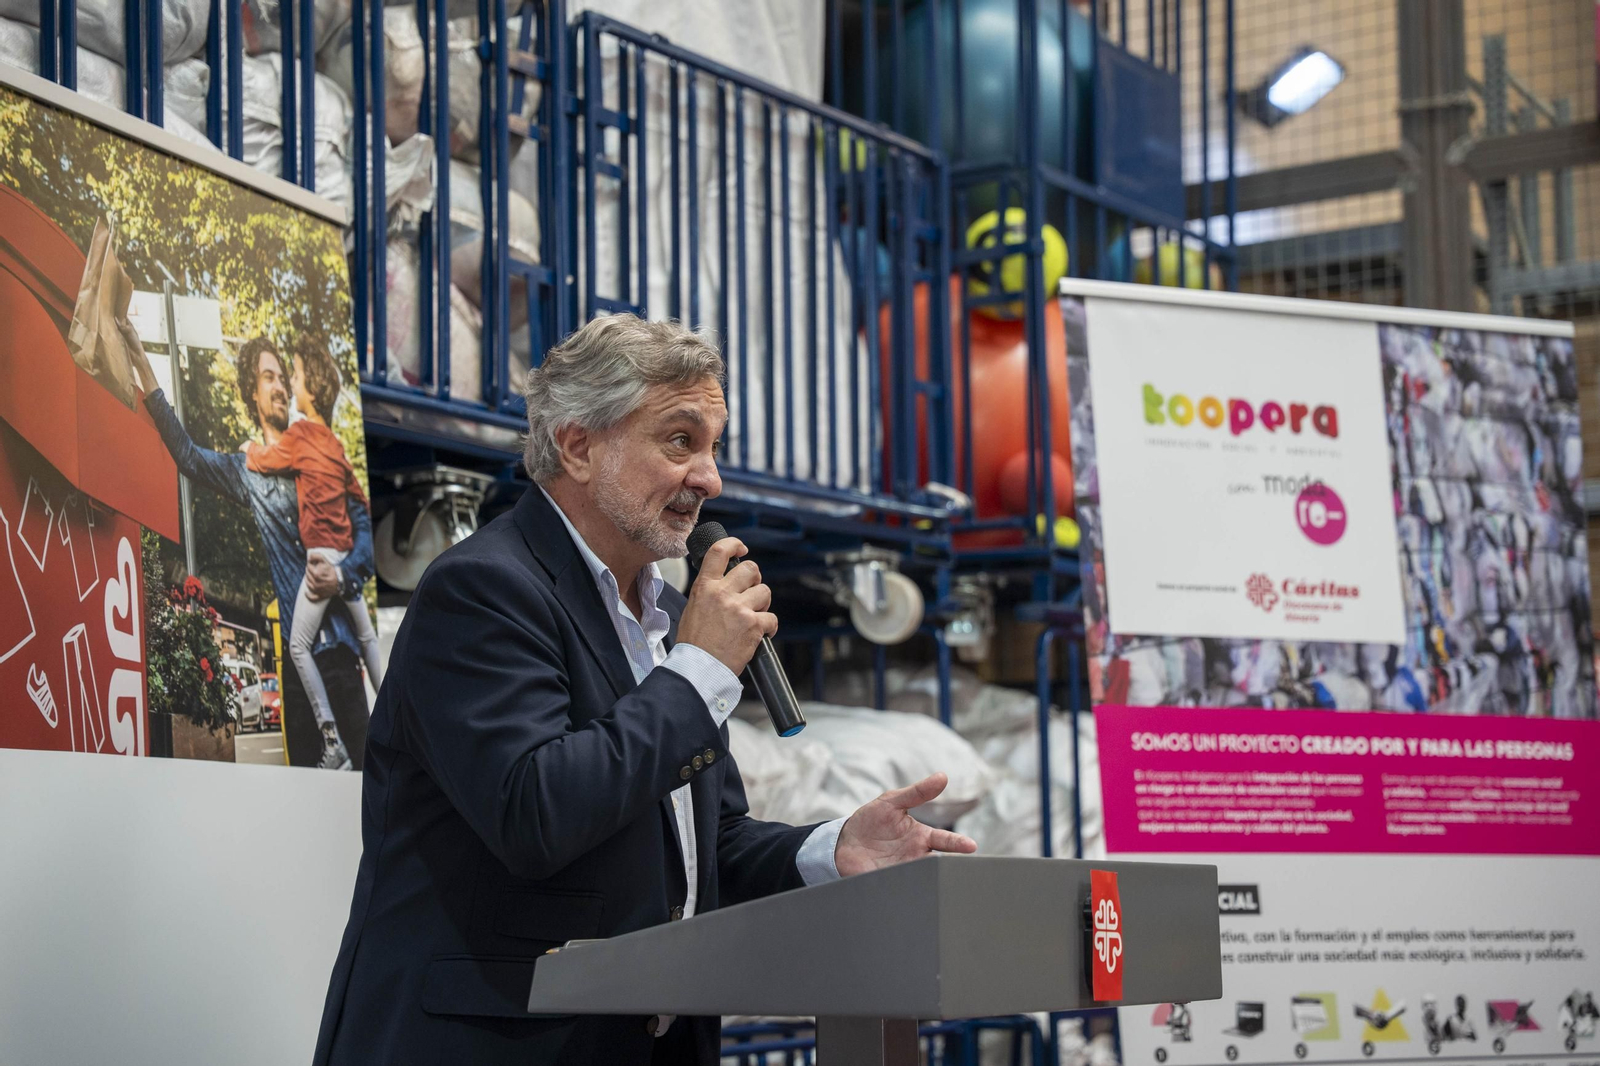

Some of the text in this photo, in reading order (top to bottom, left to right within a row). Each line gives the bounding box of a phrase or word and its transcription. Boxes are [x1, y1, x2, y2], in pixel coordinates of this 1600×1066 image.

[1142, 382, 1339, 438] koopera
[1262, 474, 1328, 497] moda
[1281, 577, 1360, 599] Cáritas
[1131, 731, 1575, 761] SOMOS UN PROYECTO CREADO POR Y PARA LAS PERSONAS
[1219, 891, 1258, 910] CIAL
[1294, 928, 1356, 943] formación
[1385, 927, 1429, 946] empleo
[1433, 931, 1466, 942] como
[1469, 927, 1546, 942] herramientas
[1238, 948, 1293, 963] construir
[1324, 946, 1376, 962] sociedad
